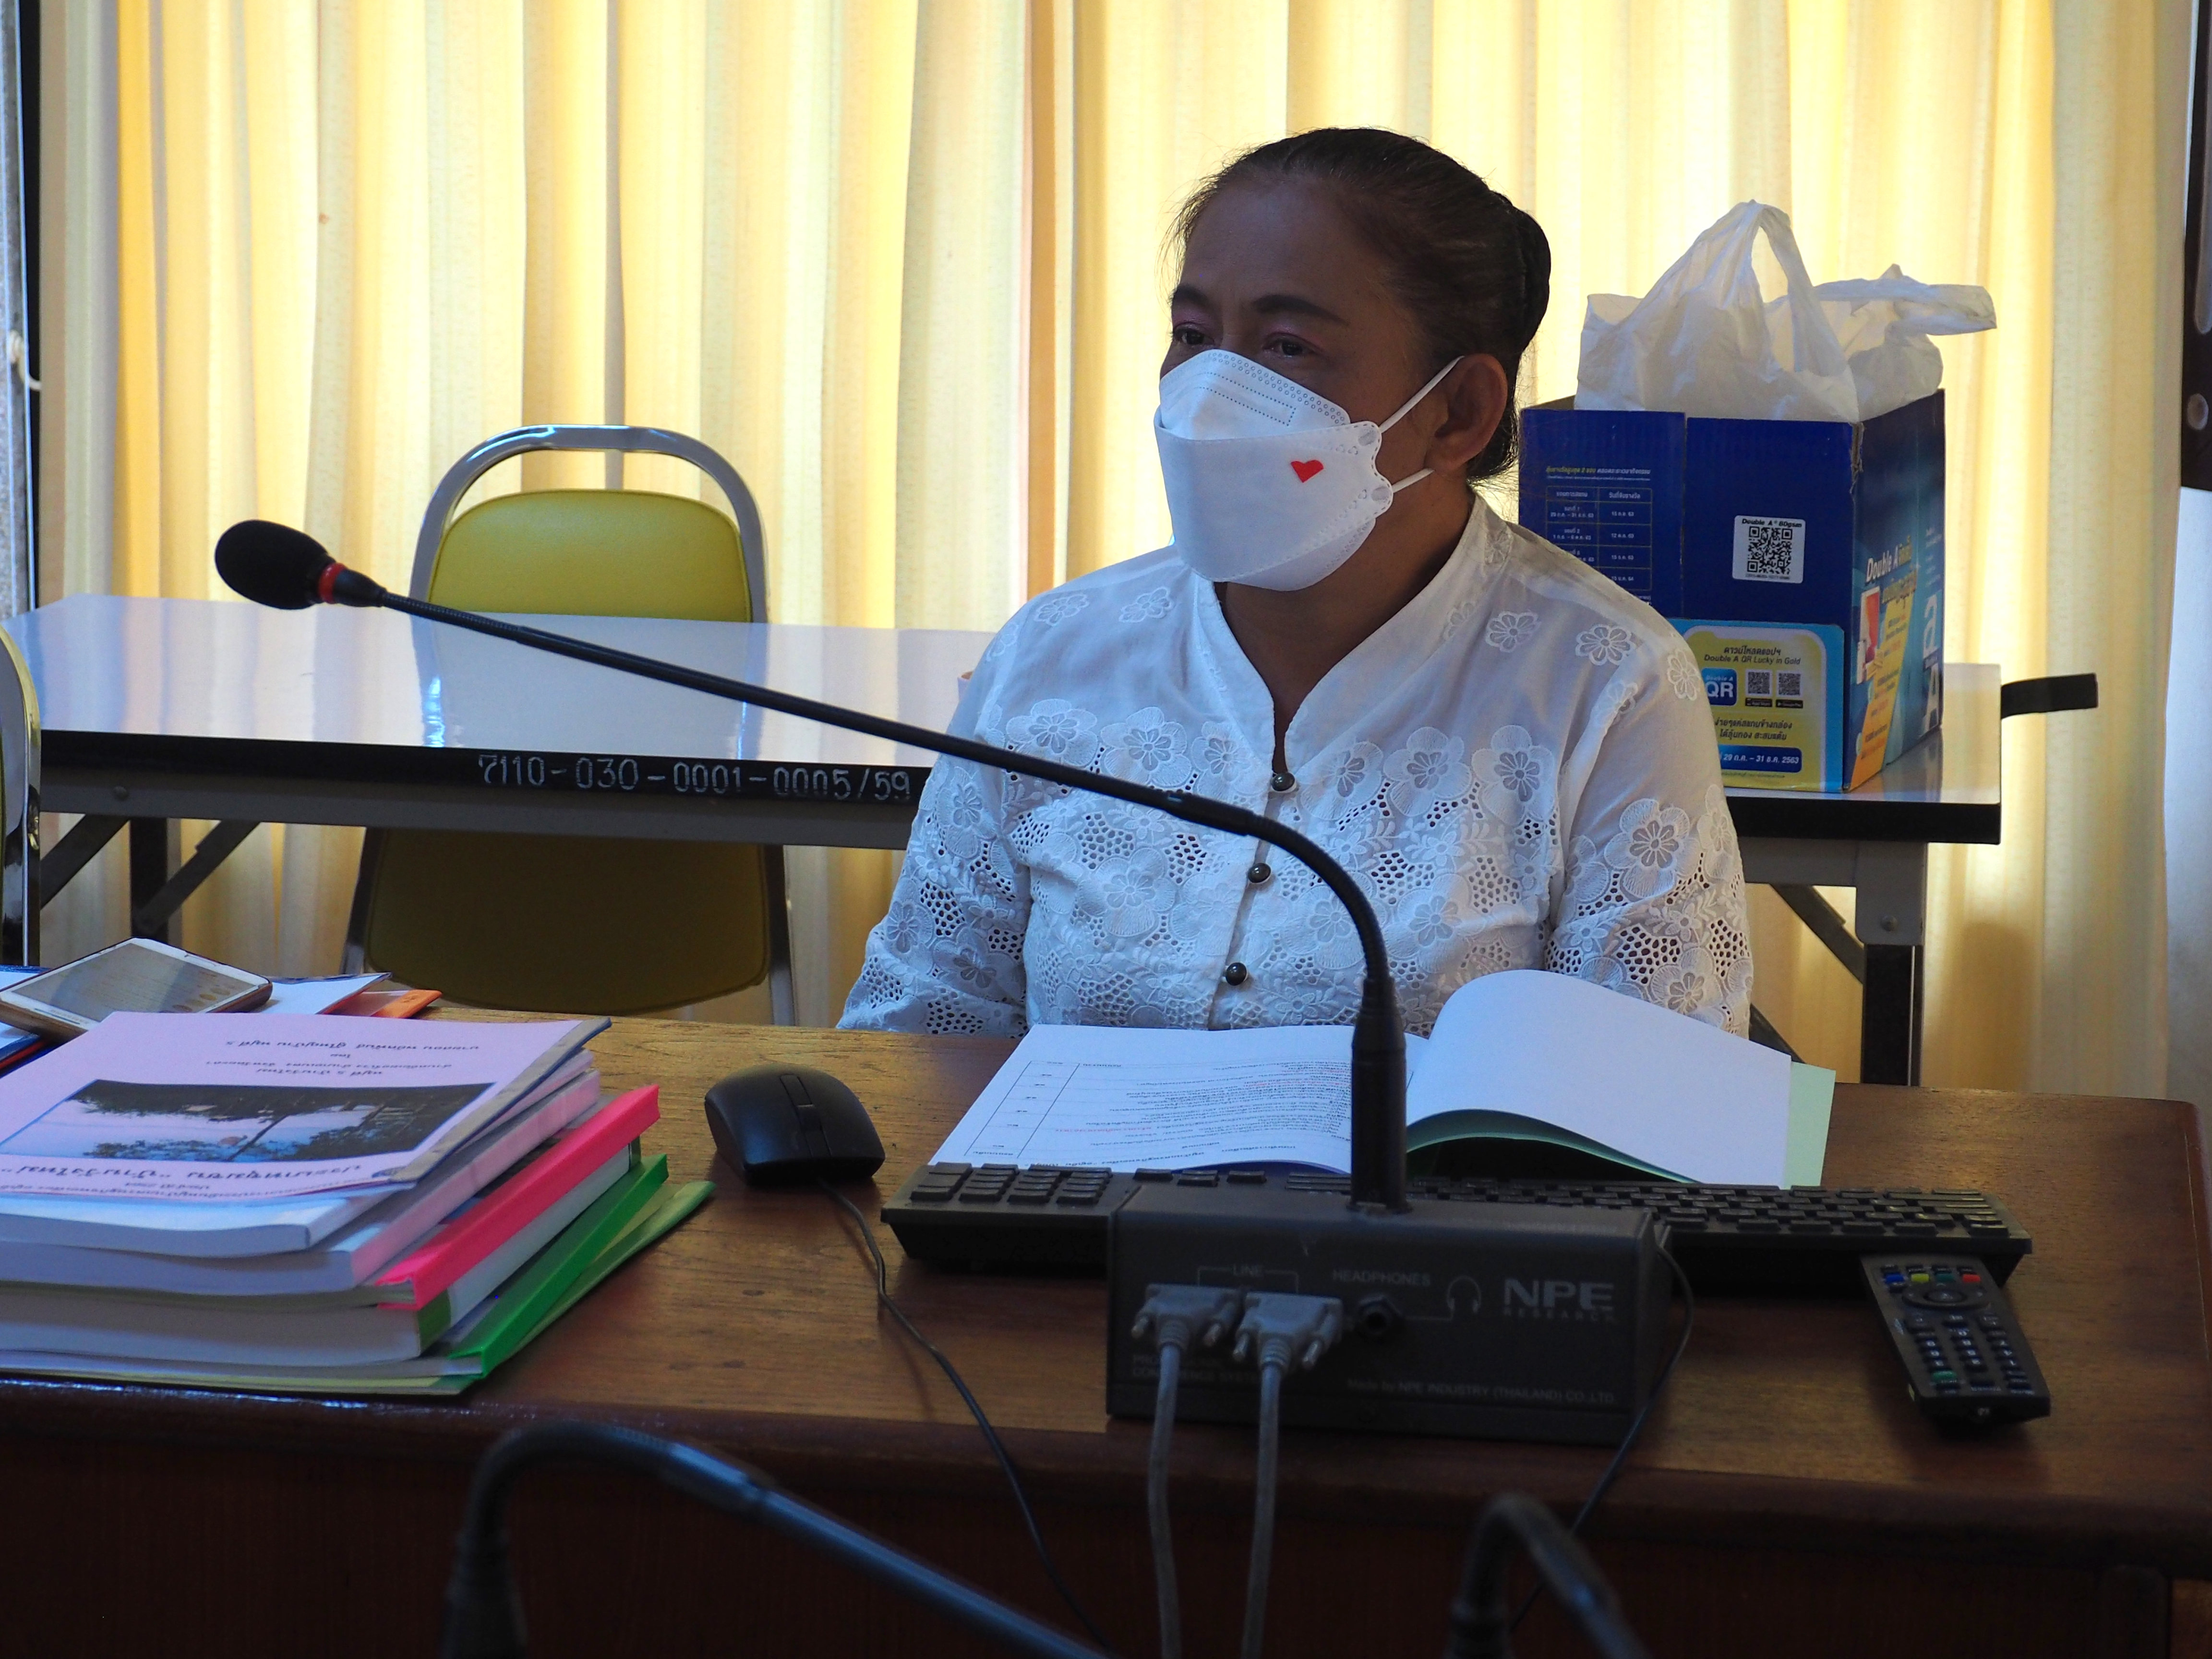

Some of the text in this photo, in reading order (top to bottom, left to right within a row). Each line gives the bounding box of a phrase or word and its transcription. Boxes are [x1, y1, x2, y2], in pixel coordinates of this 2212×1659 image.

[1866, 551, 1892, 584] Double
[1704, 654, 1731, 662] Double
[1754, 656, 1774, 665] Lucky
[1705, 681, 1734, 698] QR
[1781, 756, 1800, 764] 2563
[1232, 1264, 1262, 1277] LINE
[1332, 1269, 1431, 1287] HEADPHONES
[1503, 1278, 1615, 1311] NPE
[1503, 1307, 1616, 1324] RESEARCH
[1398, 1382, 1423, 1395] NPE
[1428, 1382, 1489, 1397] INDUSTRY
[1493, 1385, 1563, 1402] (THAILAND)
